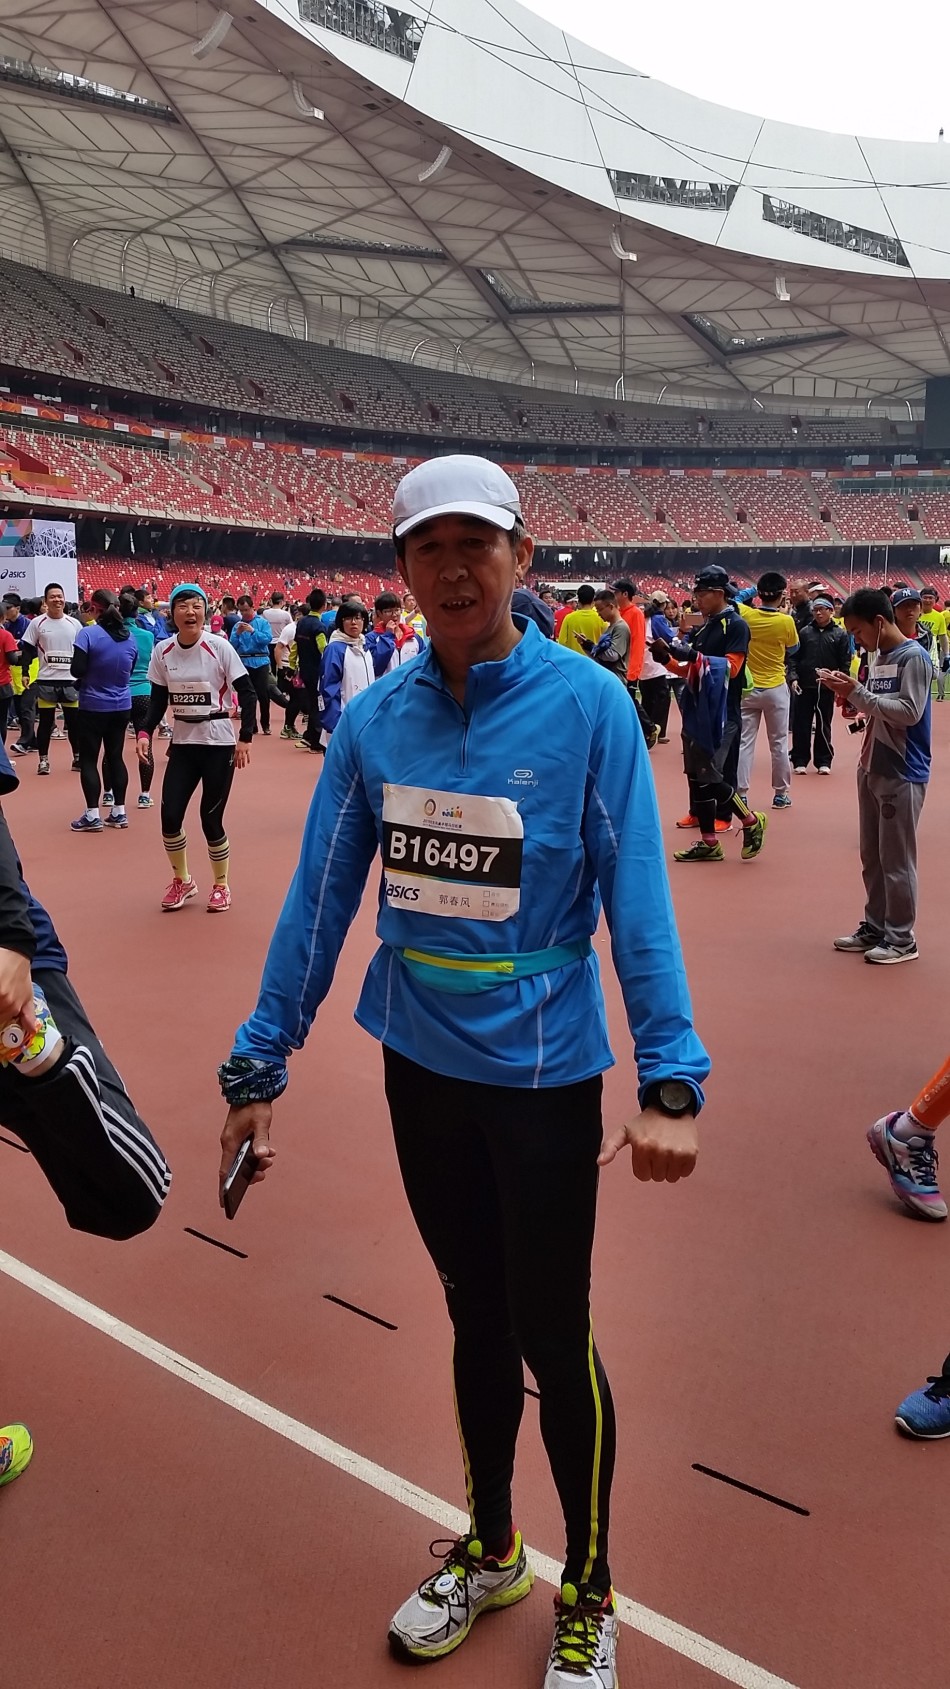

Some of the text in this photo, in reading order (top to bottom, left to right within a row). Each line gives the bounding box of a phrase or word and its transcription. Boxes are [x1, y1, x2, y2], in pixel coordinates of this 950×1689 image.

[173, 694, 206, 703] B22373
[507, 778, 539, 788] Kalenji
[389, 830, 500, 873] B16497
[439, 894, 471, 908] 郭春风
